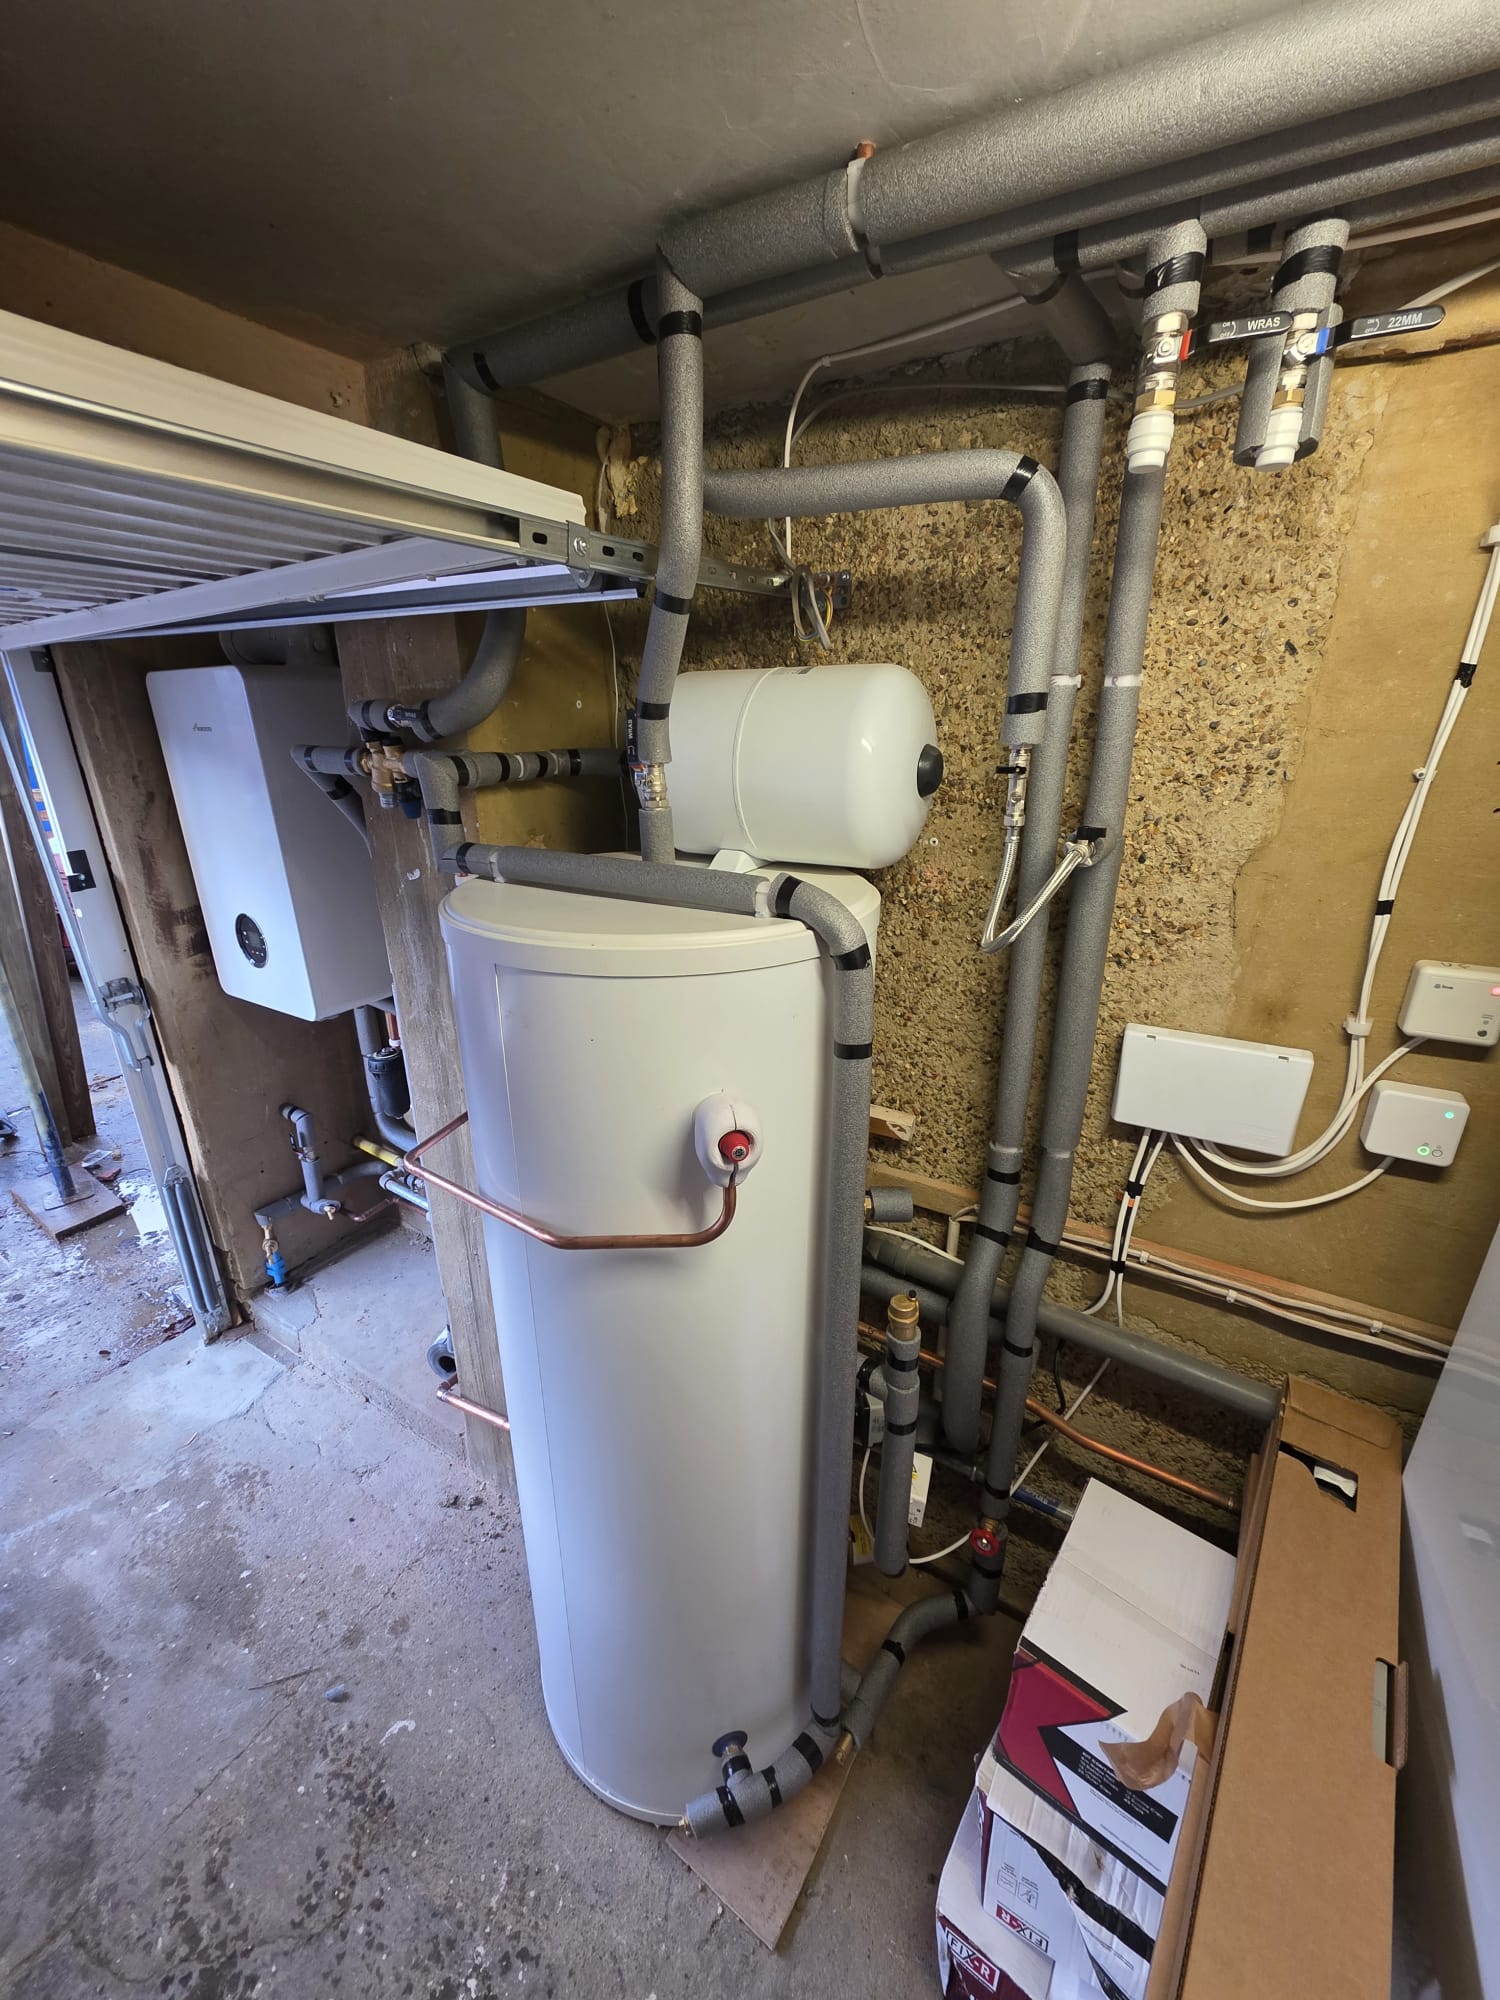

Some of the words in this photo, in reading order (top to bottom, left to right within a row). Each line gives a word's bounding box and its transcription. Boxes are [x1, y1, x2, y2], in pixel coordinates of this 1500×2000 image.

[1247, 316, 1281, 331] WRAS
[1387, 312, 1423, 329] 22MM
[1000, 1908, 1044, 1947] FIX-R
[950, 1936, 991, 1981] FIX-R
